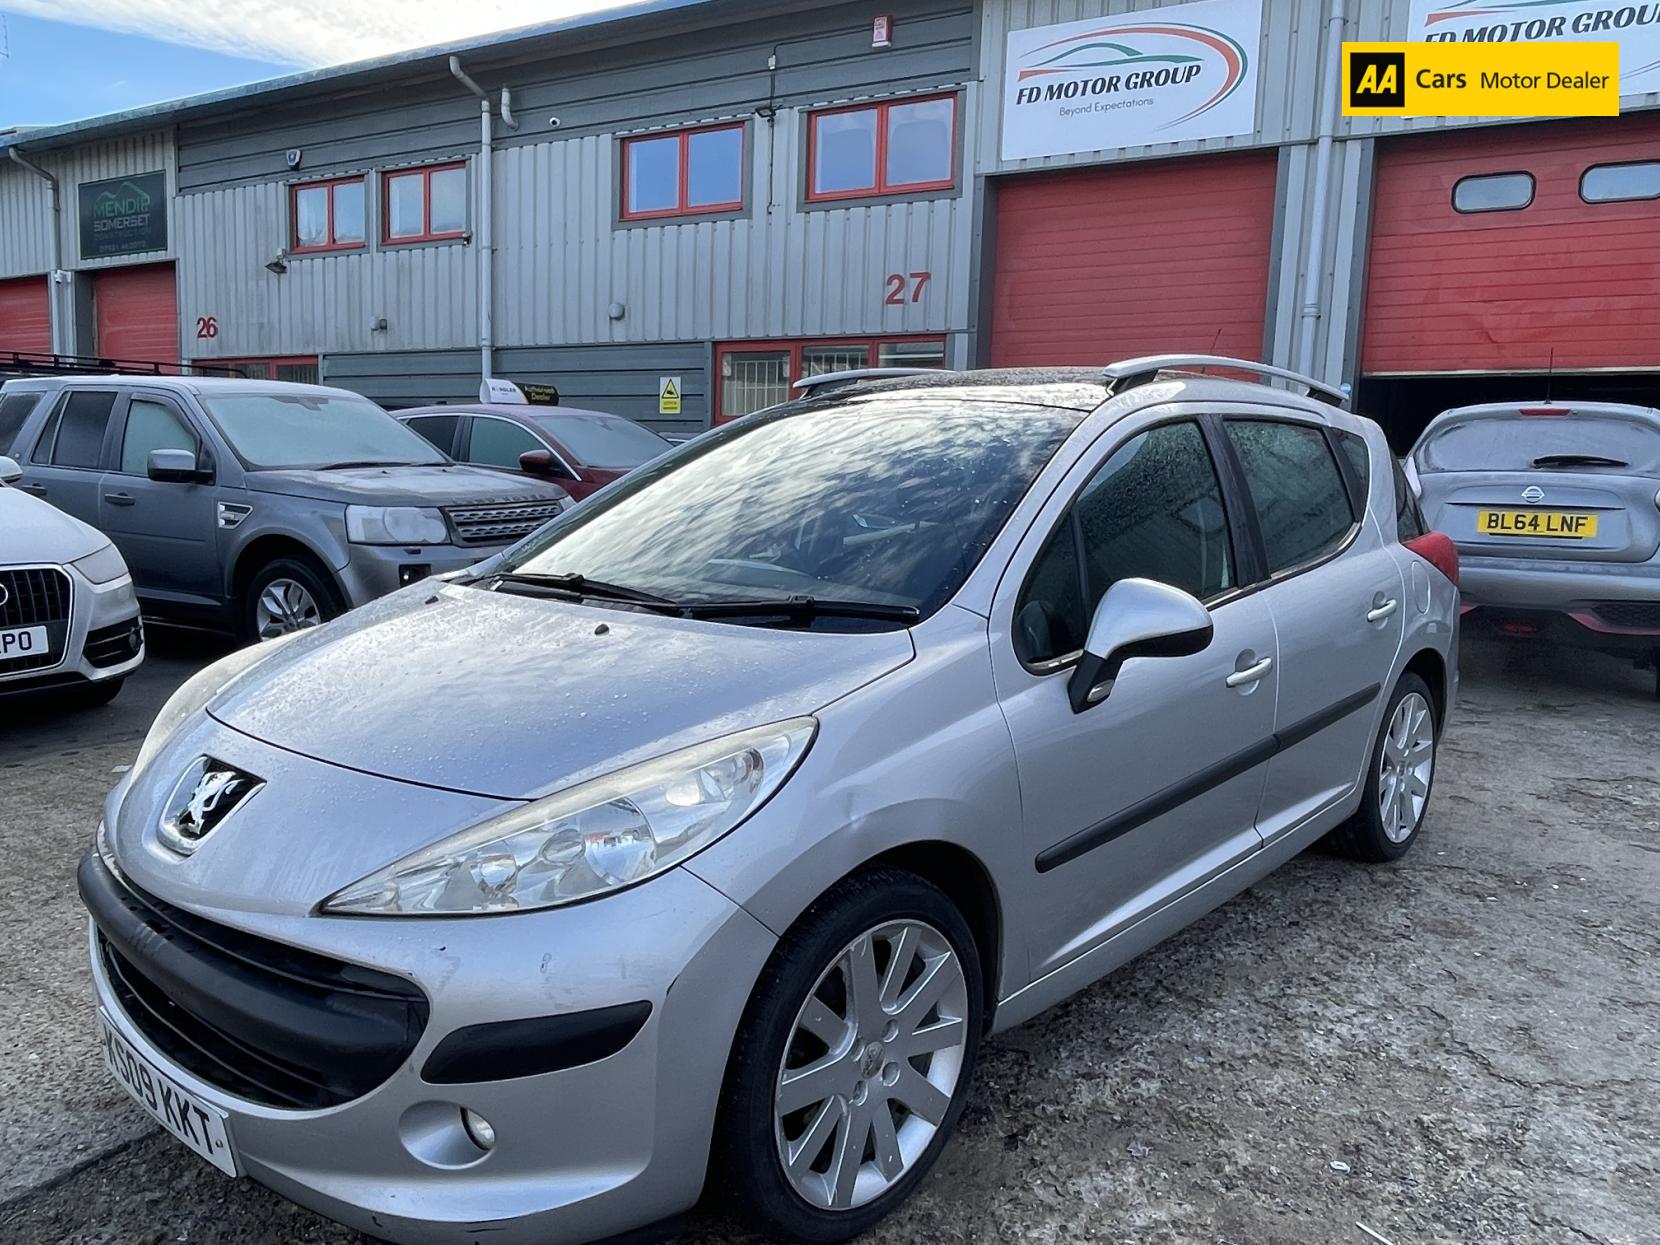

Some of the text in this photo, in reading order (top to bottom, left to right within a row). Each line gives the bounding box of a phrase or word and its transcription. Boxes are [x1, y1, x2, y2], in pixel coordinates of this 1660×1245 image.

[1461, 3, 1660, 42] MOTOR GROU
[1016, 64, 1202, 105] FD MOTOR GROUP
[1059, 98, 1154, 117] Beyond Expectations
[94, 196, 151, 218] MENDIP
[94, 213, 150, 232] SOMERSET
[885, 272, 931, 305] 27
[197, 316, 218, 338] 26
[1487, 513, 1588, 533] BL64 LNF
[0, 631, 32, 654] PO
[158, 1078, 213, 1155] KKT
